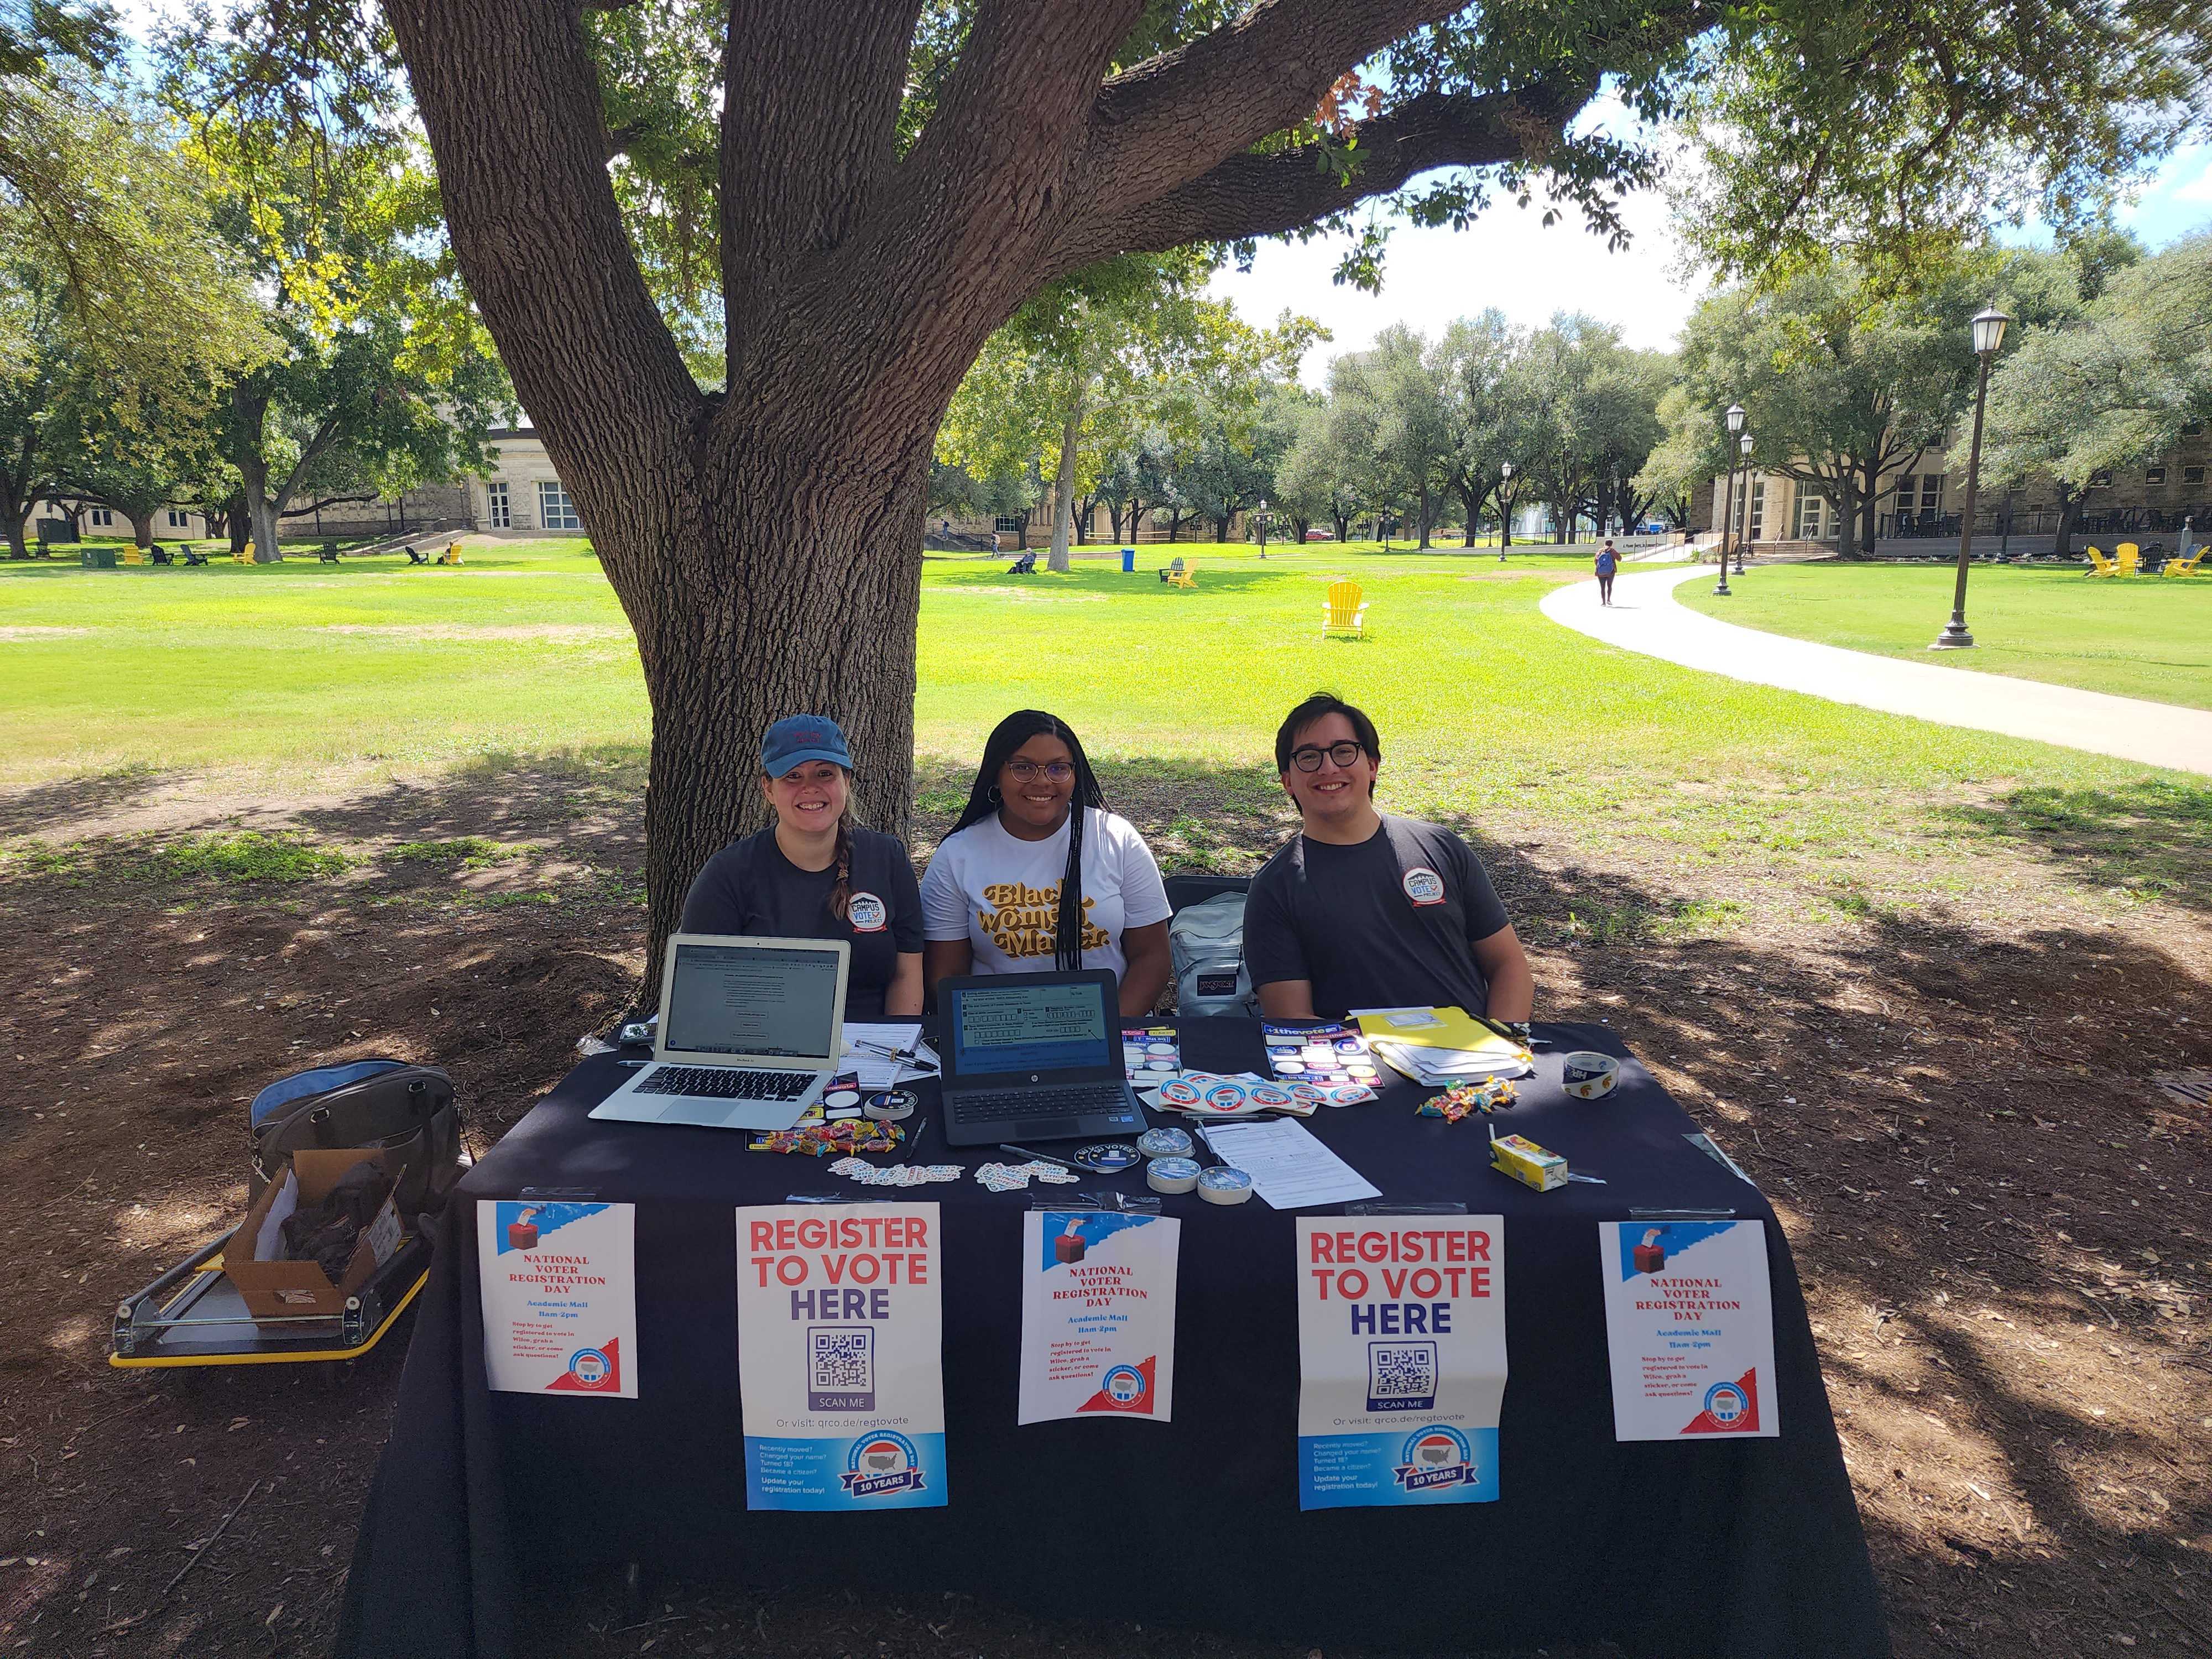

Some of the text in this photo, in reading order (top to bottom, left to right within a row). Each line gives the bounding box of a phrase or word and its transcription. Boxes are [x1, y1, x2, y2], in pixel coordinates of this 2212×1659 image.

[1408, 878, 1437, 887] CAMPUS
[1411, 885, 1431, 894] VOTE
[852, 903, 880, 912] CAMPUS
[853, 911, 873, 920] VOTE
[992, 927, 1110, 958] Maer
[1198, 980, 1234, 991] JANSPORT
[1105, 1145, 1136, 1154] VOTES!
[750, 1217, 928, 1252] REGISTER
[1311, 1231, 1491, 1264] REGISTER
[524, 1255, 589, 1265] NATIONAL
[535, 1265, 579, 1274] VOTER
[751, 1253, 927, 1288] TO VOTE
[1070, 1266, 1133, 1277] NATIONAL
[509, 1274, 606, 1285] REGISTRATION
[1080, 1276, 1121, 1287] VOTER
[1311, 1267, 1490, 1301] TO VOTE
[1650, 1278, 1722, 1288] NATIONAL
[544, 1285, 571, 1293] DAY
[1053, 1287, 1147, 1300] REGISTRATION
[1663, 1289, 1710, 1299] VOTER
[791, 1288, 889, 1321] HERE
[1086, 1297, 1112, 1307] DAY
[1636, 1301, 1740, 1311] REGISTRATION
[1068, 1314, 1107, 1324] Academic
[1351, 1302, 1451, 1335] HERE
[1674, 1311, 1703, 1321] DAY
[818, 1397, 864, 1408] SCAN ME
[1377, 1400, 1423, 1410] SCAN ME
[776, 1417, 909, 1429] Or visit: qrco.de/regtovote
[1349, 1416, 1371, 1425] visit:
[1374, 1413, 1465, 1425] qrco.de/regtovote
[759, 1444, 786, 1453] Recently
[761, 1477, 787, 1485] Update
[1314, 1475, 1340, 1484] Update
[1413, 1469, 1457, 1485] 10 YEARS
[860, 1475, 904, 1492] 10 YEARS
[1314, 1483, 1354, 1491] registration
[761, 1485, 801, 1494] registration
